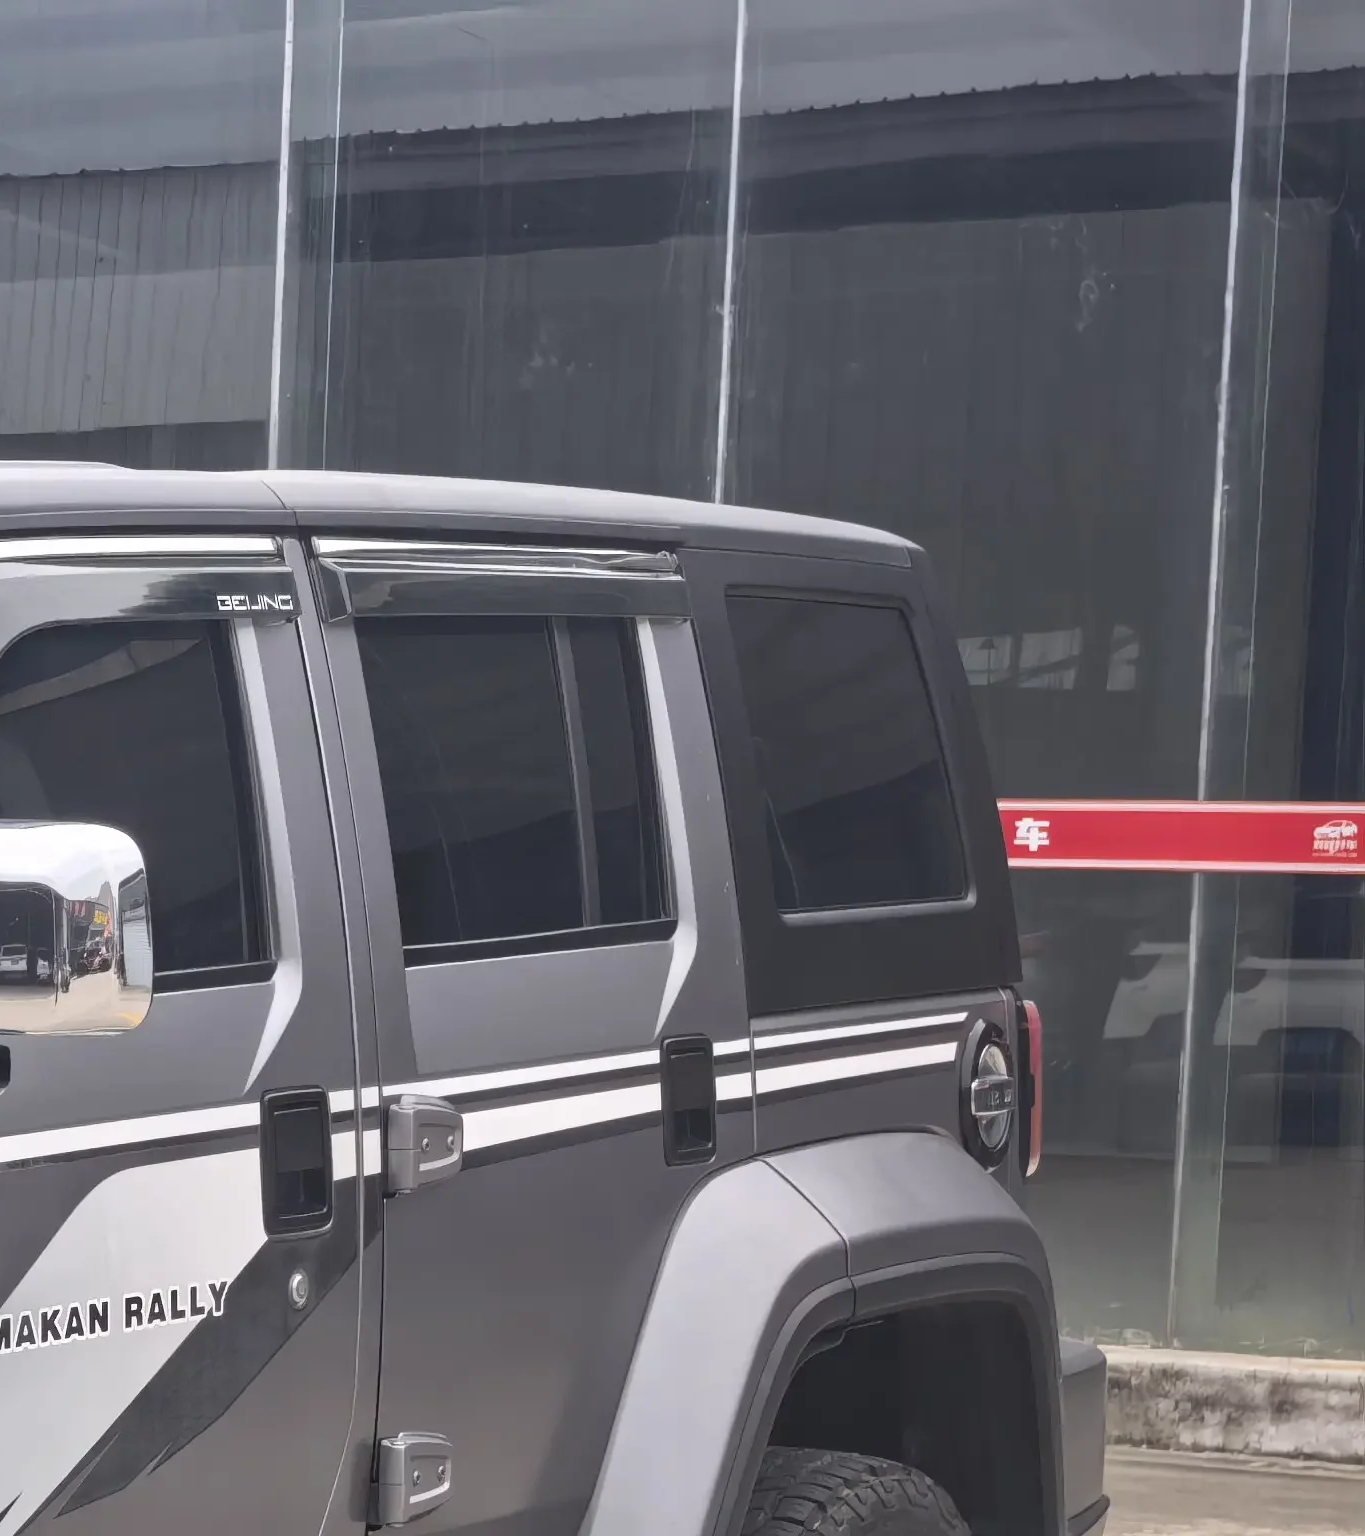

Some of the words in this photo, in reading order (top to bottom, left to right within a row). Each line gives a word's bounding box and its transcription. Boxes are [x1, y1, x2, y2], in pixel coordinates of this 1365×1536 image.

[216, 594, 294, 611] BEIJING
[1013, 817, 1050, 852] 车
[123, 1279, 233, 1331] RALLY
